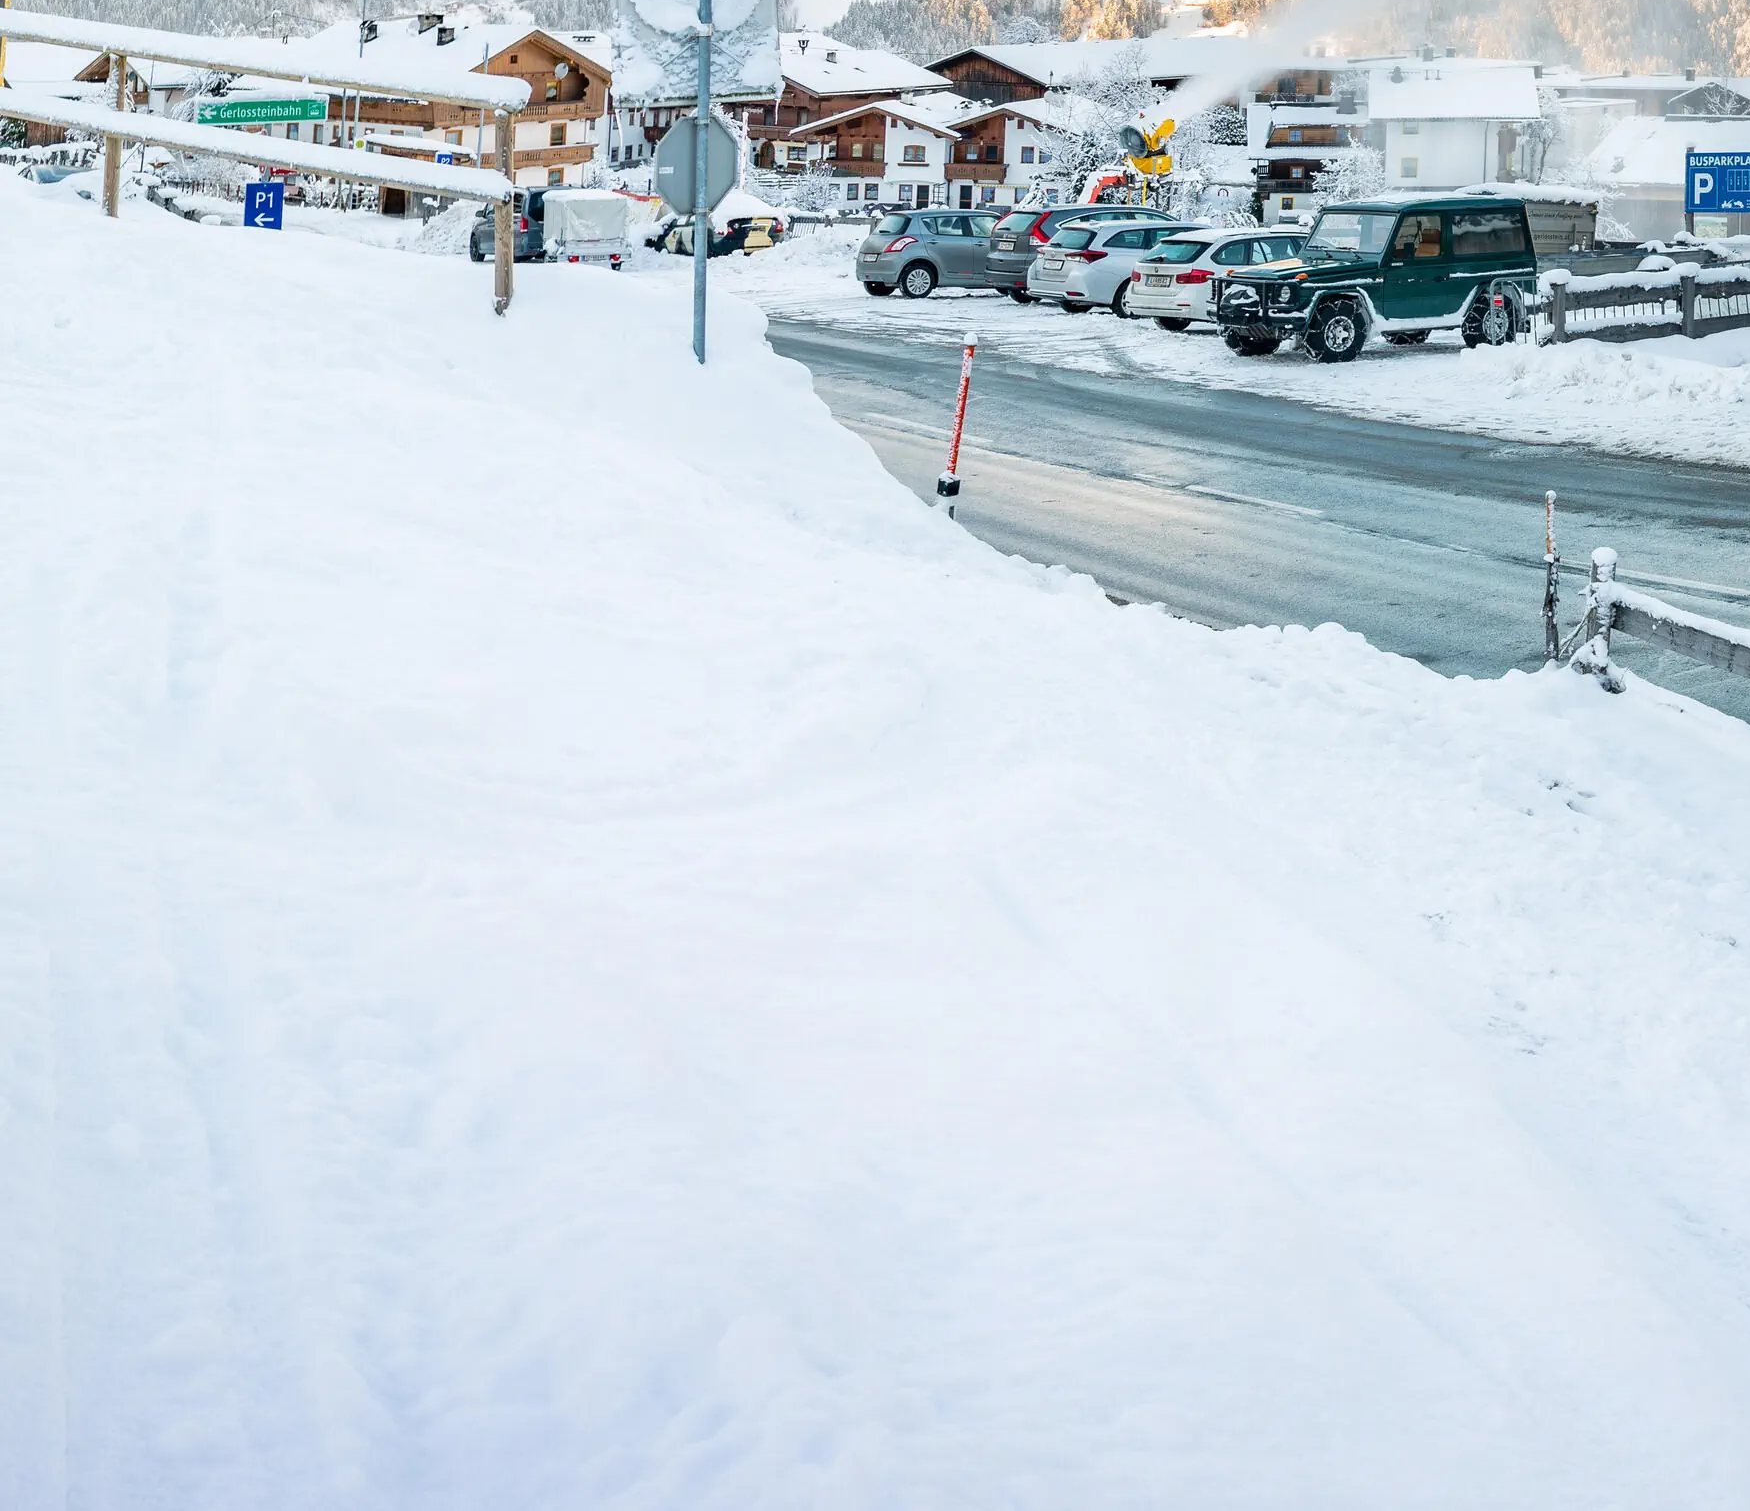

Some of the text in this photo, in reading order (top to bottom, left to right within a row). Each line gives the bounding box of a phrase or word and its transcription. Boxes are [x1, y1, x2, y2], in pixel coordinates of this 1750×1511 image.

[220, 105, 302, 119] Gerlossteinbahn
[1694, 172, 1714, 205] P
[255, 191, 274, 209] P1
